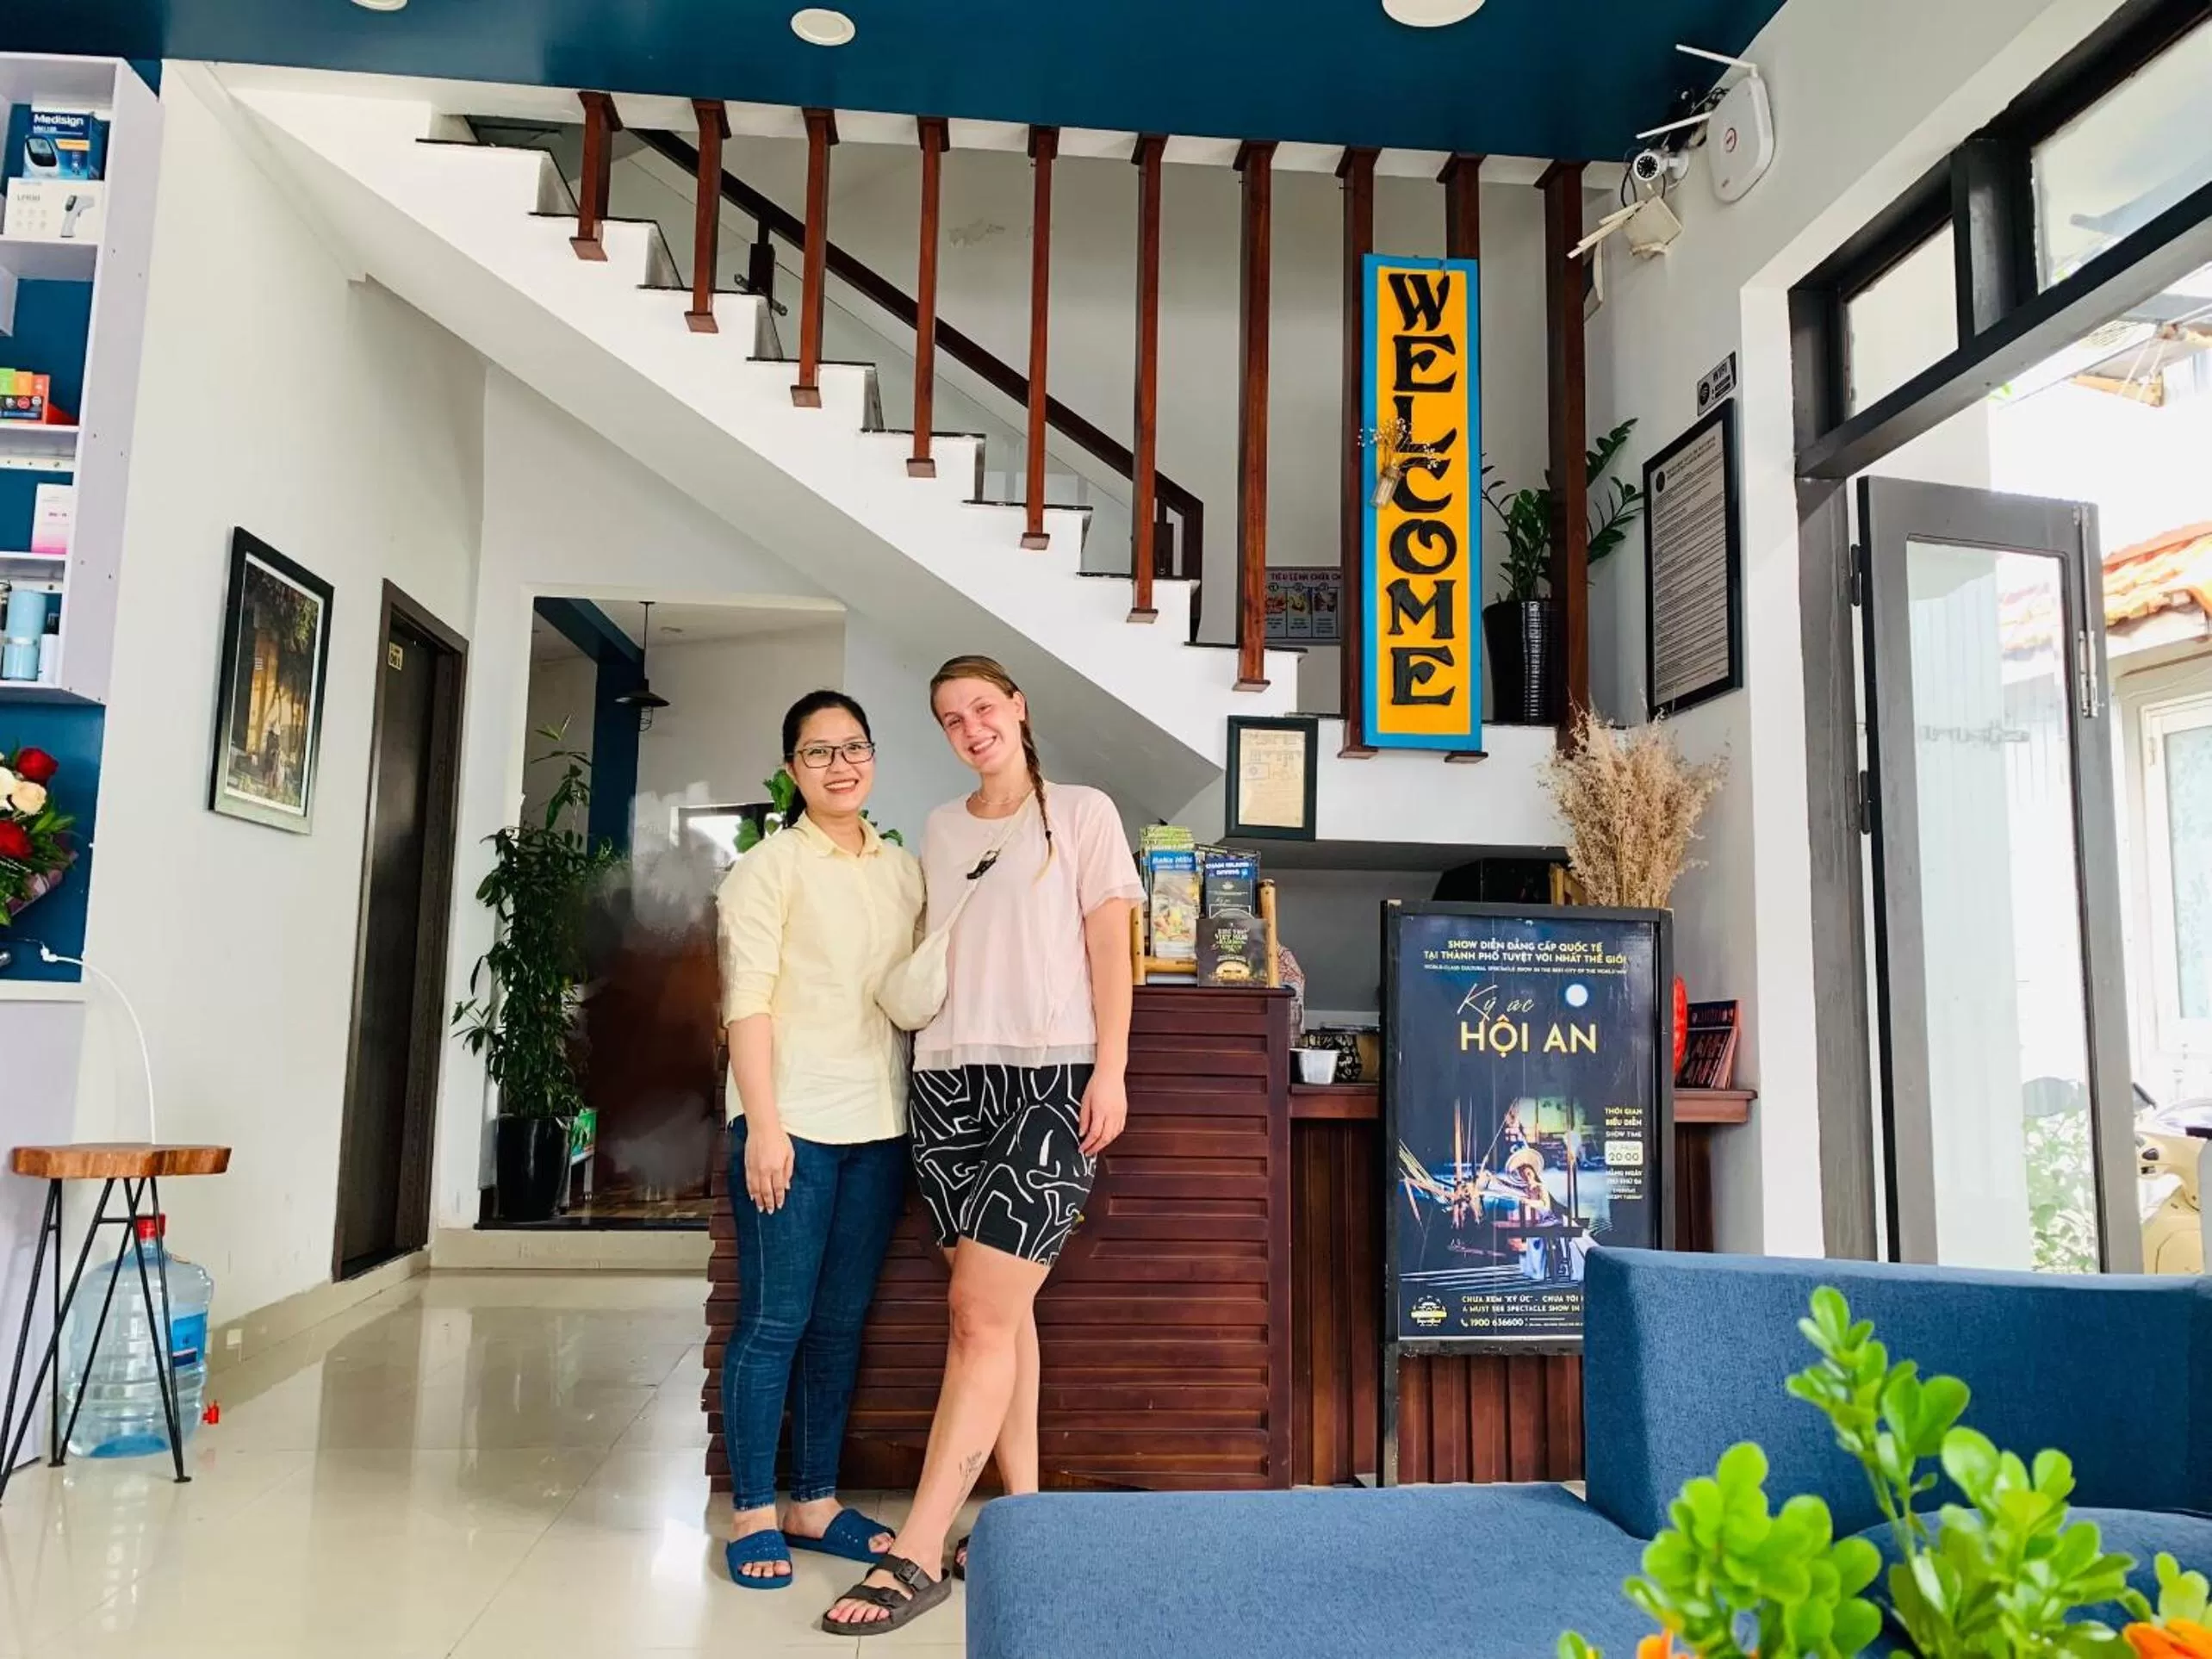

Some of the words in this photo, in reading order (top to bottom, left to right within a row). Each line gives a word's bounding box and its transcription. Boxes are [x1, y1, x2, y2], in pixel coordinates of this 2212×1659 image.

[34, 114, 84, 127] Medisign
[1388, 273, 1457, 706] WELCOME
[1447, 940, 1478, 949] SHOW
[1558, 941, 1588, 953] QUỐC
[1424, 950, 1438, 960] TẠI
[1440, 949, 1476, 960] THÀNH
[1478, 949, 1500, 961] PHỐ
[1502, 951, 1532, 964] TUYỆT
[1555, 952, 1581, 963] NHẤT
[1460, 1014, 1529, 1059] HỘI
[1543, 1022, 1597, 1053] AN
[1469, 1318, 1490, 1327] 1900
[1491, 1317, 1525, 1327] 636600
